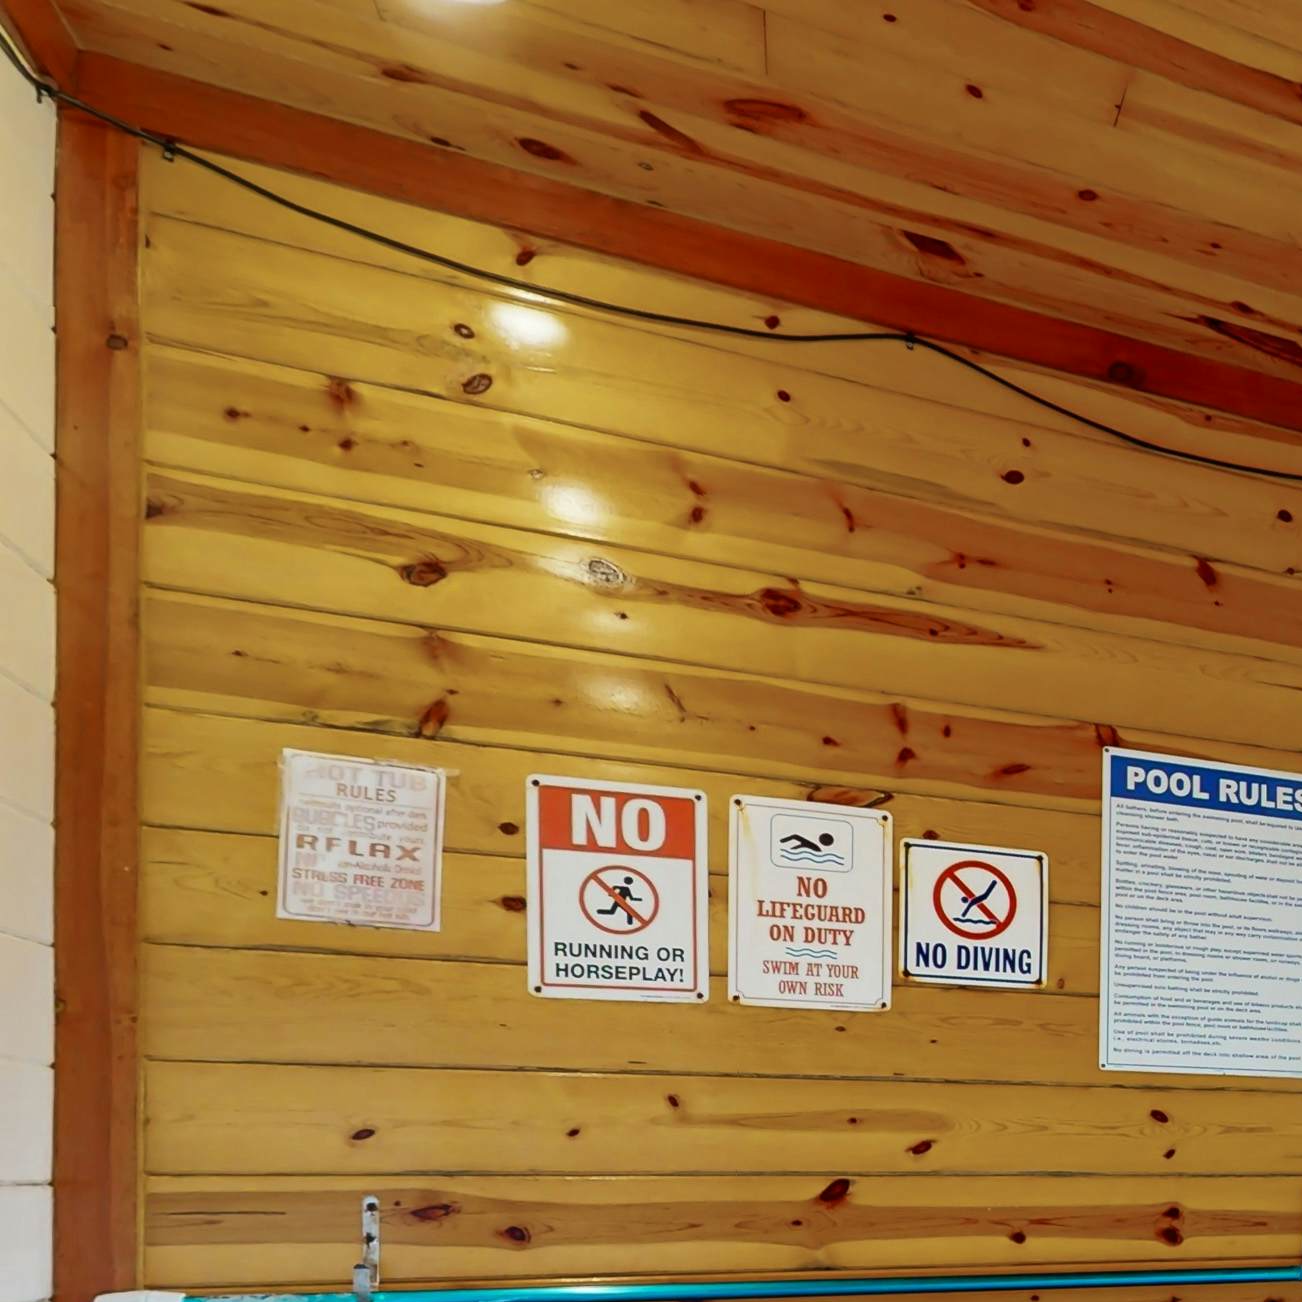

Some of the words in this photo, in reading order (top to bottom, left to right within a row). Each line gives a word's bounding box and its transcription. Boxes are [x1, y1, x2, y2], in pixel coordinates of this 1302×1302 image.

[336, 783, 397, 802] RULES
[1126, 765, 1210, 801] POOL
[571, 793, 666, 852] NO
[353, 874, 385, 888] FREE
[390, 878, 425, 891] ZONE
[796, 876, 828, 899] NO
[757, 899, 866, 925] LIFEGUARD
[769, 924, 794, 943] ON
[804, 926, 855, 946] DUTY
[554, 942, 649, 962] RUNNING
[657, 946, 685, 963] OR
[915, 941, 947, 969] NO
[956, 944, 1032, 975] DIVING
[555, 962, 685, 983] HORSEPLAY!
[762, 960, 799, 976] SWIM
[806, 963, 822, 977] AT
[825, 964, 859, 979] YOUR
[779, 980, 808, 996] OWN
[815, 982, 845, 997] RISK
